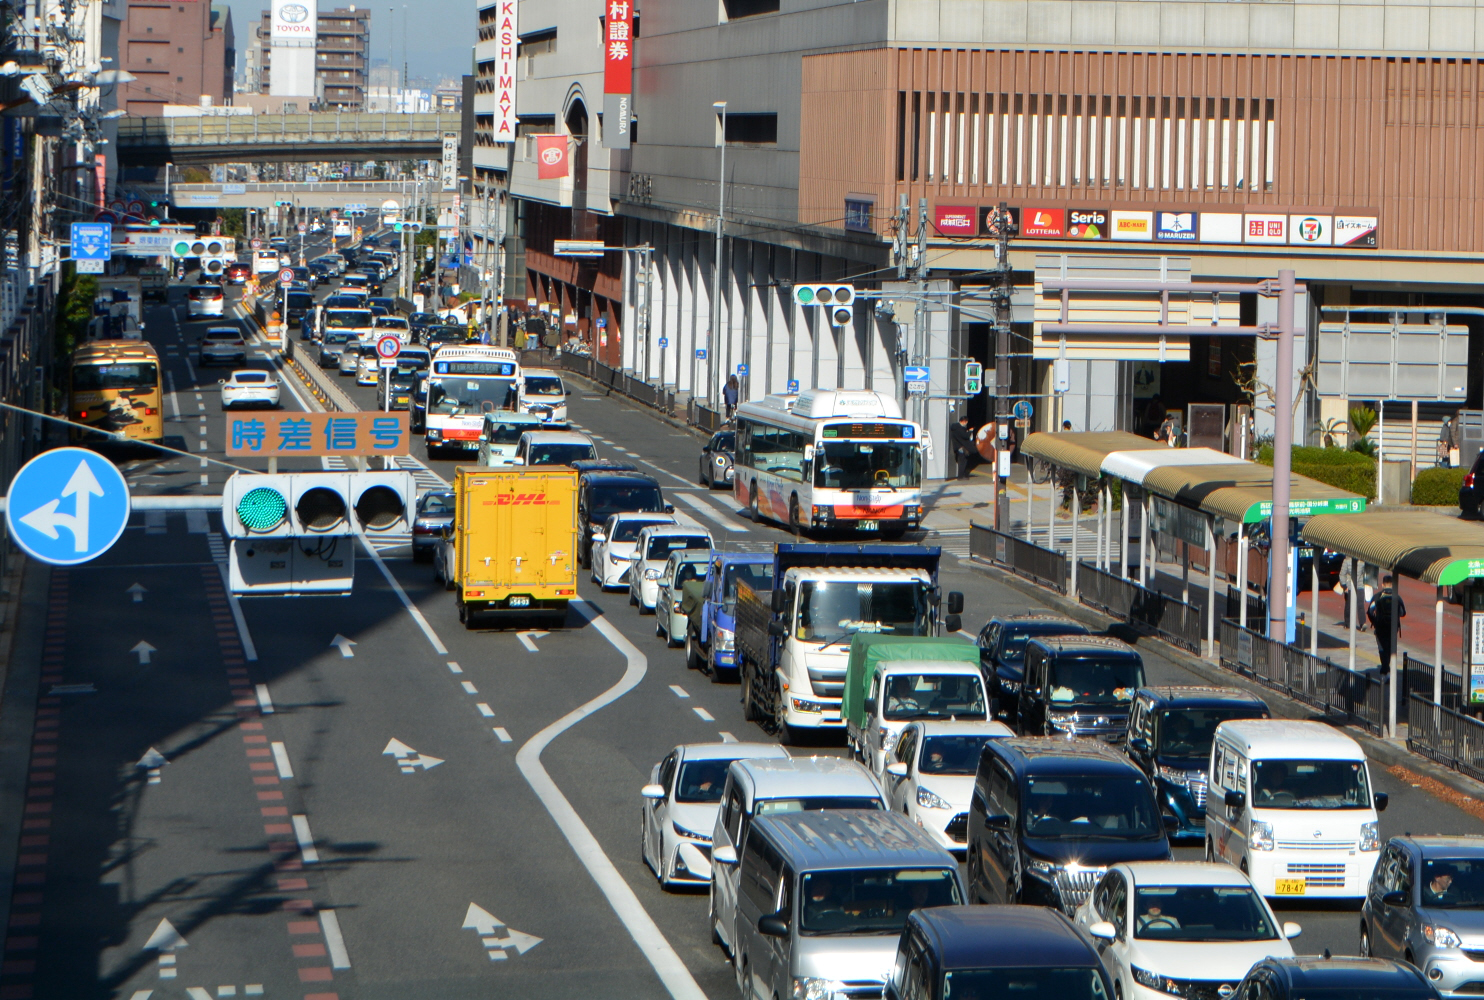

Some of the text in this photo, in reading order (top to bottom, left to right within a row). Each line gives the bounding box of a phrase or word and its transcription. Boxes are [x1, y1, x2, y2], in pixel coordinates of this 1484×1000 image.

[276, 24, 311, 33] TOYOTA
[618, 97, 627, 135] NOMURA
[443, 141, 453, 186] ねぼけ堂
[1071, 211, 1105, 224] Seria
[1164, 232, 1196, 240] MARUZEN
[232, 417, 403, 451] 時差信号
[495, 493, 547, 506] DHL
[1351, 501, 1359, 511] 9
[1281, 883, 1304, 893] 78-47
